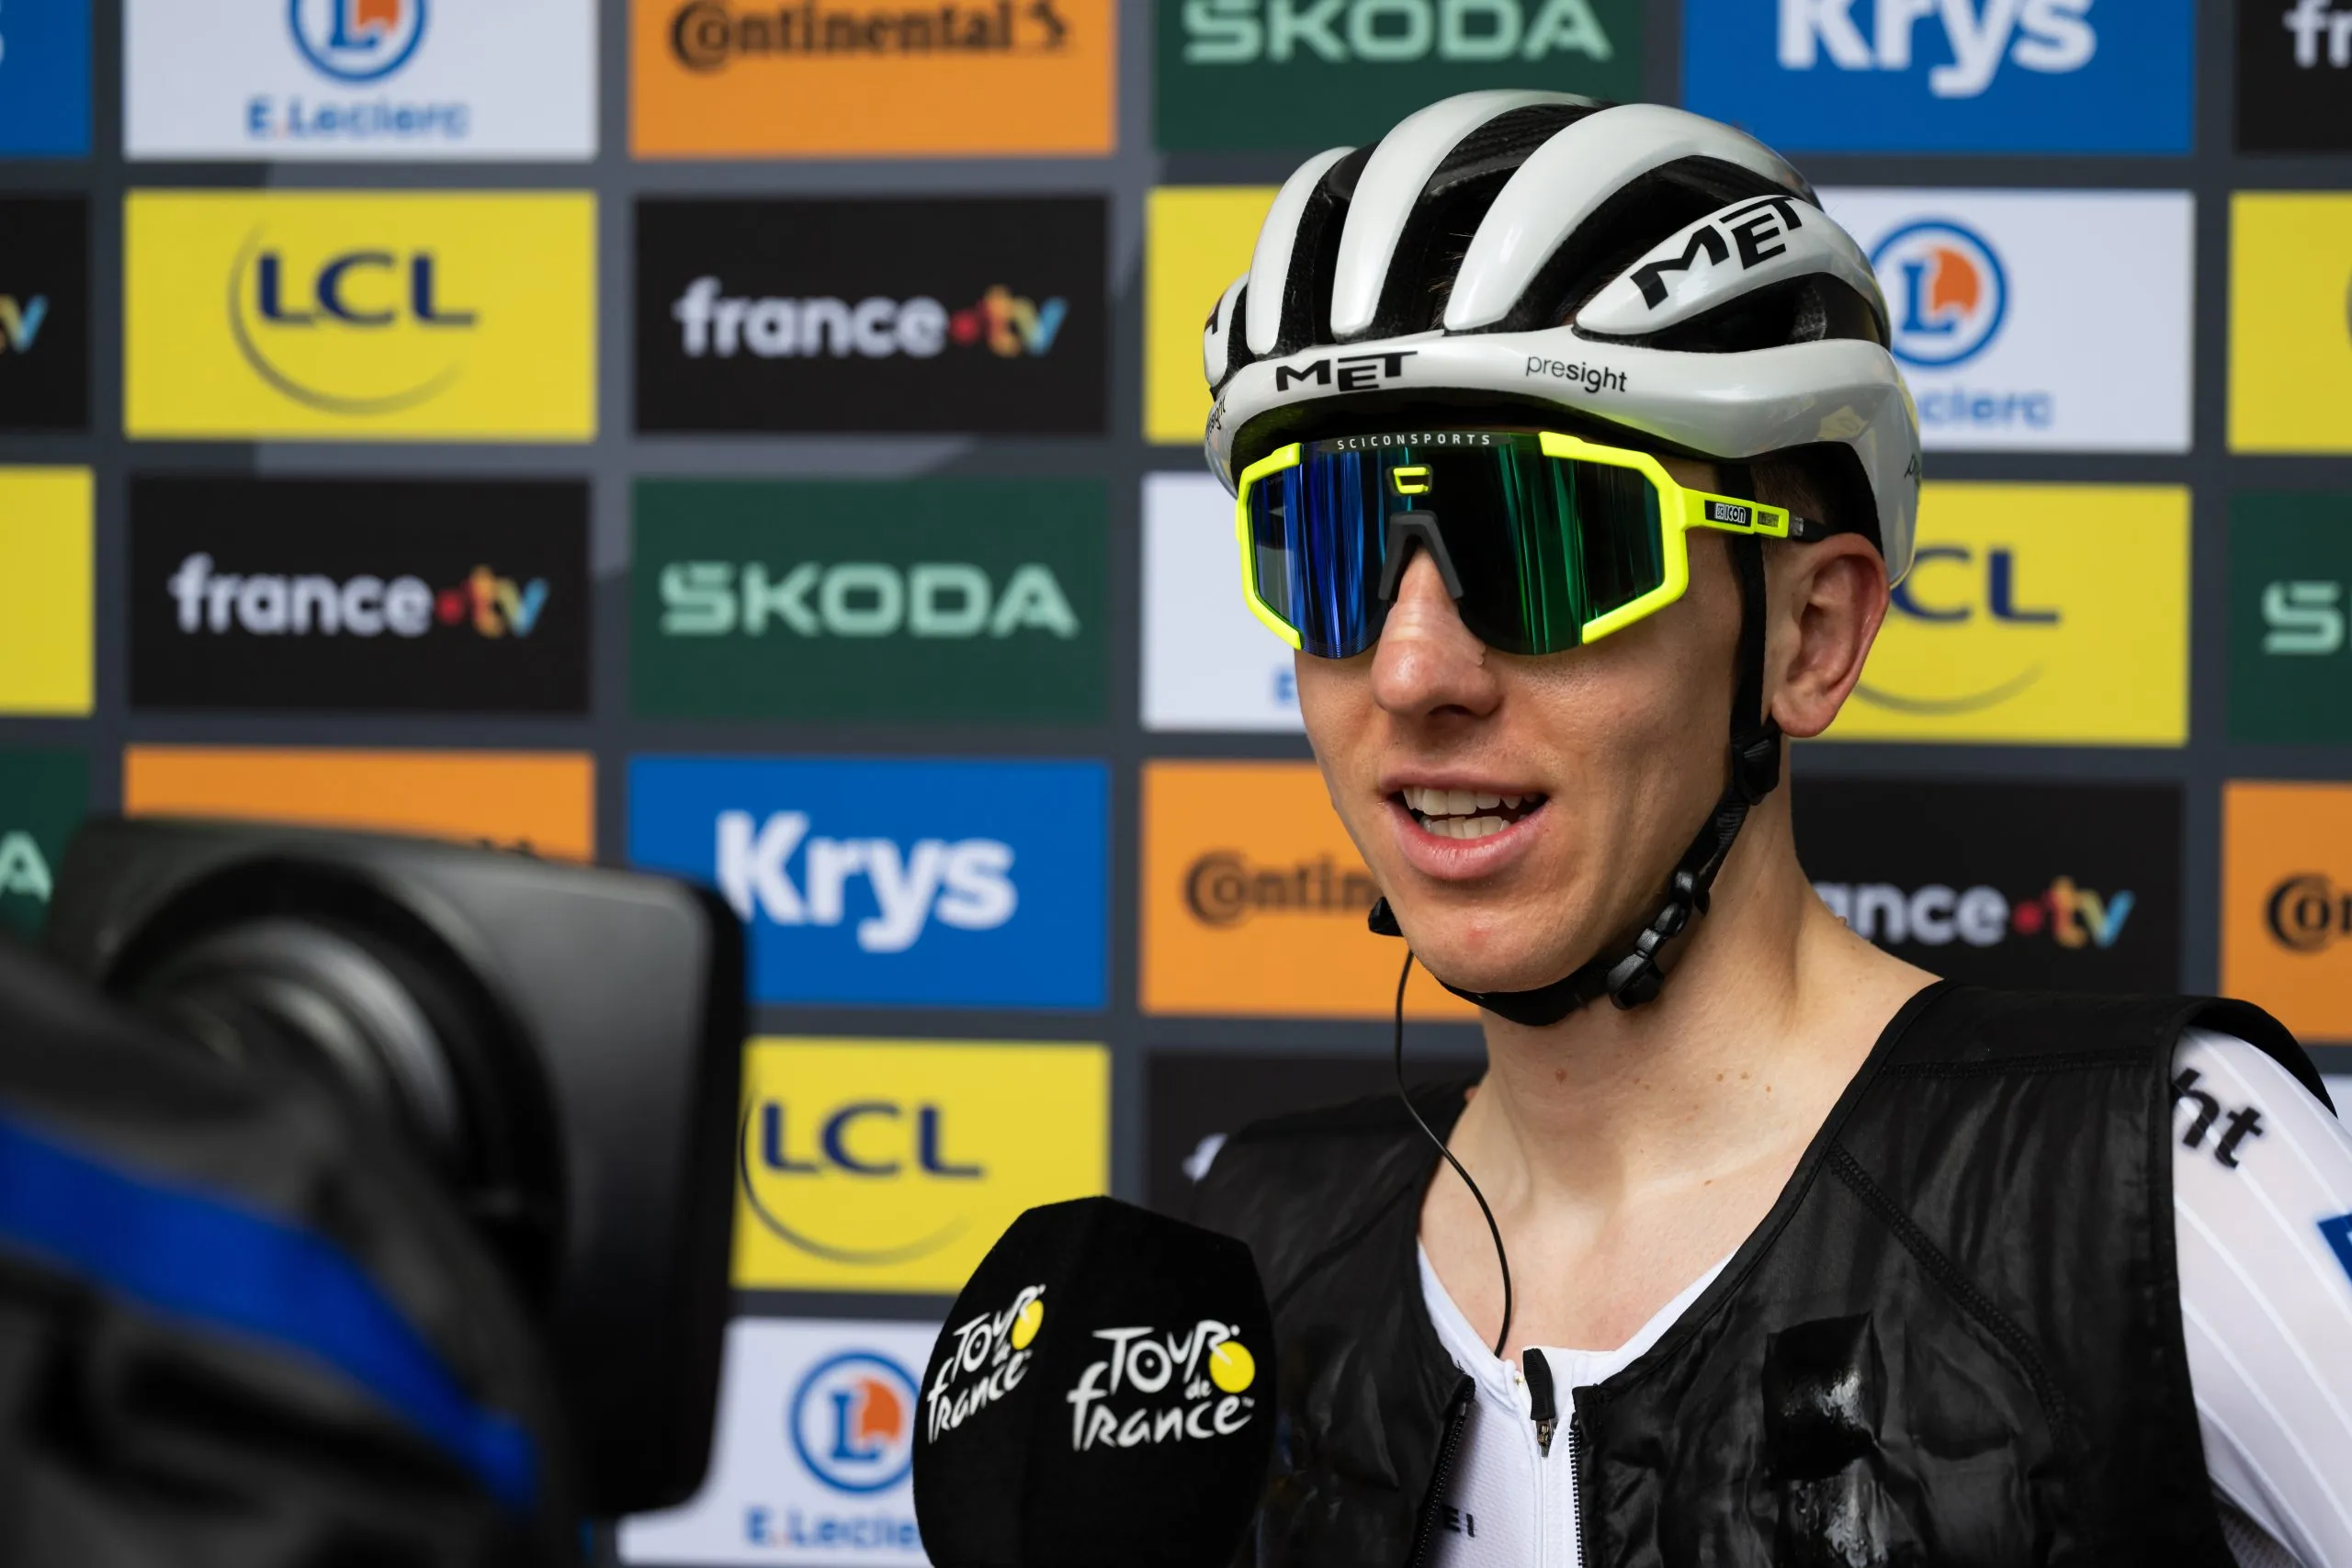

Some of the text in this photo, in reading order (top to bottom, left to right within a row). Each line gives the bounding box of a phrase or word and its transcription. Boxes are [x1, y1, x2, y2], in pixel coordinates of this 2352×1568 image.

[671, 0, 1014, 73] Continental
[1777, 0, 2098, 97] Krys
[244, 98, 470, 138] E.Leclerc
[256, 248, 481, 328] LCL
[1630, 196, 1803, 310] MET
[1275, 351, 1418, 392] MET
[1525, 355, 1627, 393] presight
[1917, 386, 2055, 429] clerc
[1337, 434, 1490, 450] SCICONSPORTS
[1889, 547, 2063, 627] CL
[715, 807, 1020, 953] Krys
[1182, 848, 1383, 931] Contin
[760, 1100, 986, 1179] LCL
[1184, 1371, 1213, 1401] de
[745, 1503, 921, 1551] E.Lecle
